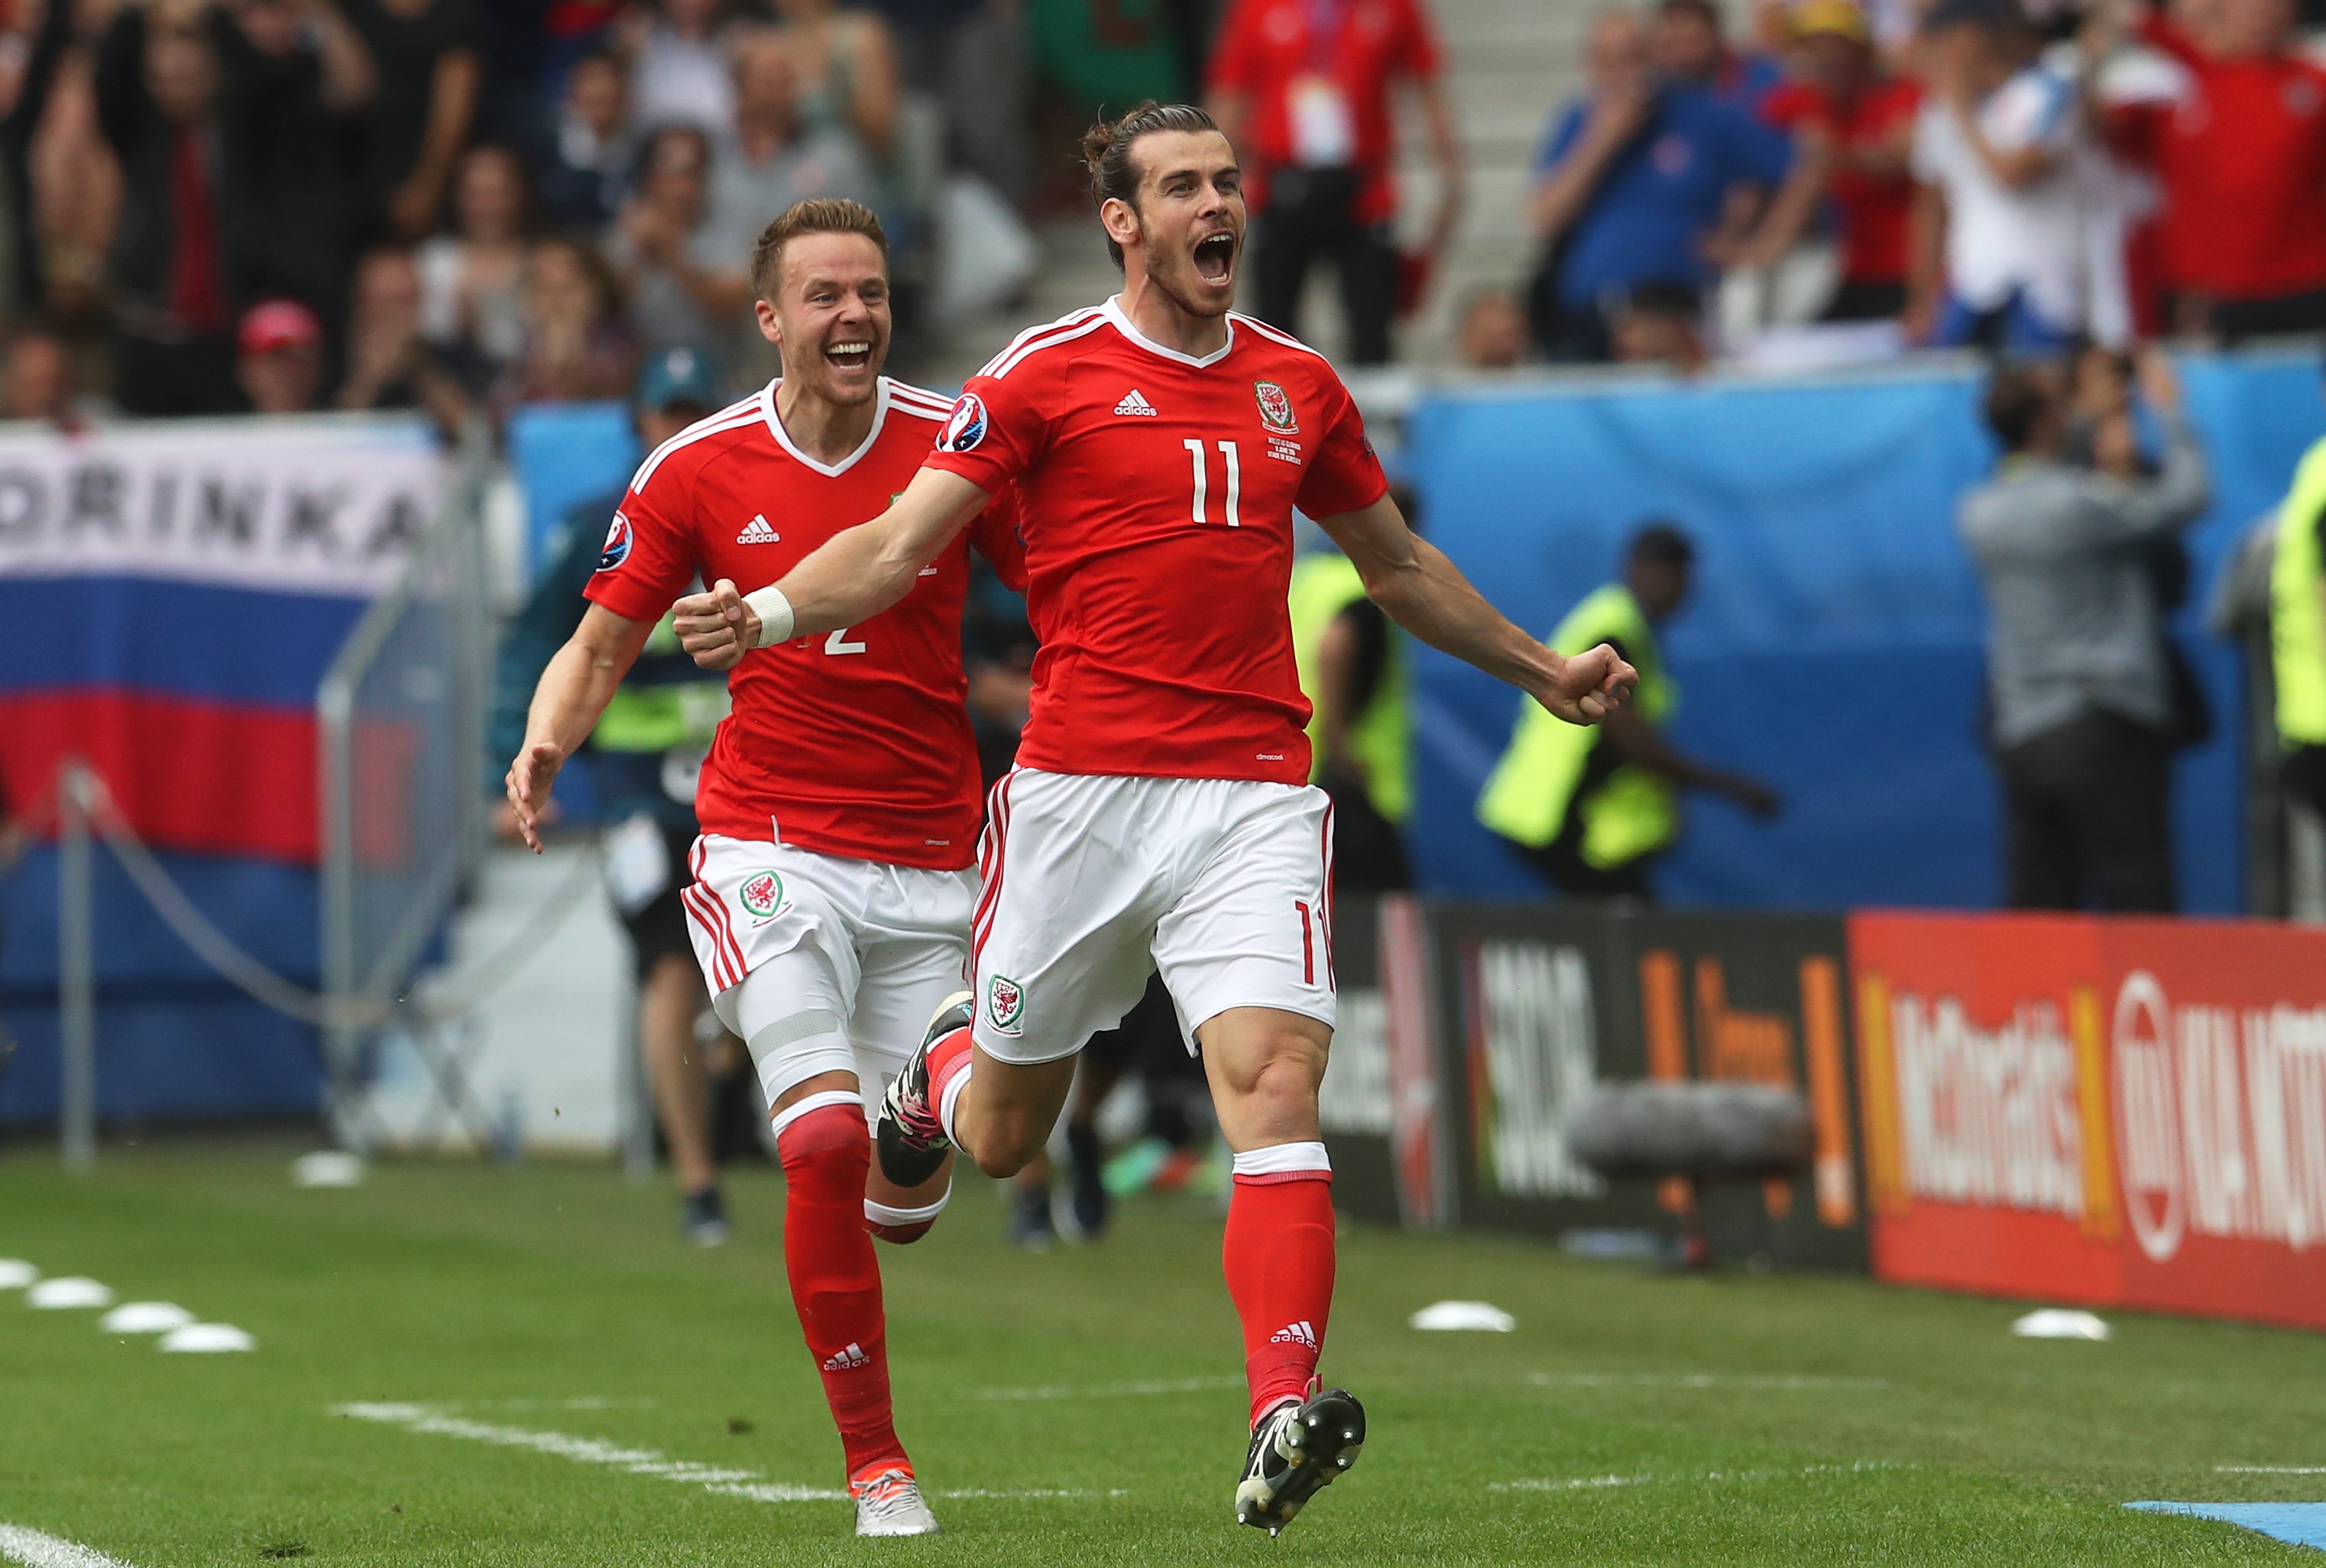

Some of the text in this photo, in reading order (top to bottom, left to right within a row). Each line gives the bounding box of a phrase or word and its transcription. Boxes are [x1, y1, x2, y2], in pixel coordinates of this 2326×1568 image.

[1113, 405, 1158, 416] adidas
[1183, 438, 1240, 527] 11
[736, 532, 780, 544] adidas
[1270, 1333, 1318, 1353] adidas
[823, 1356, 870, 1371] adidas
